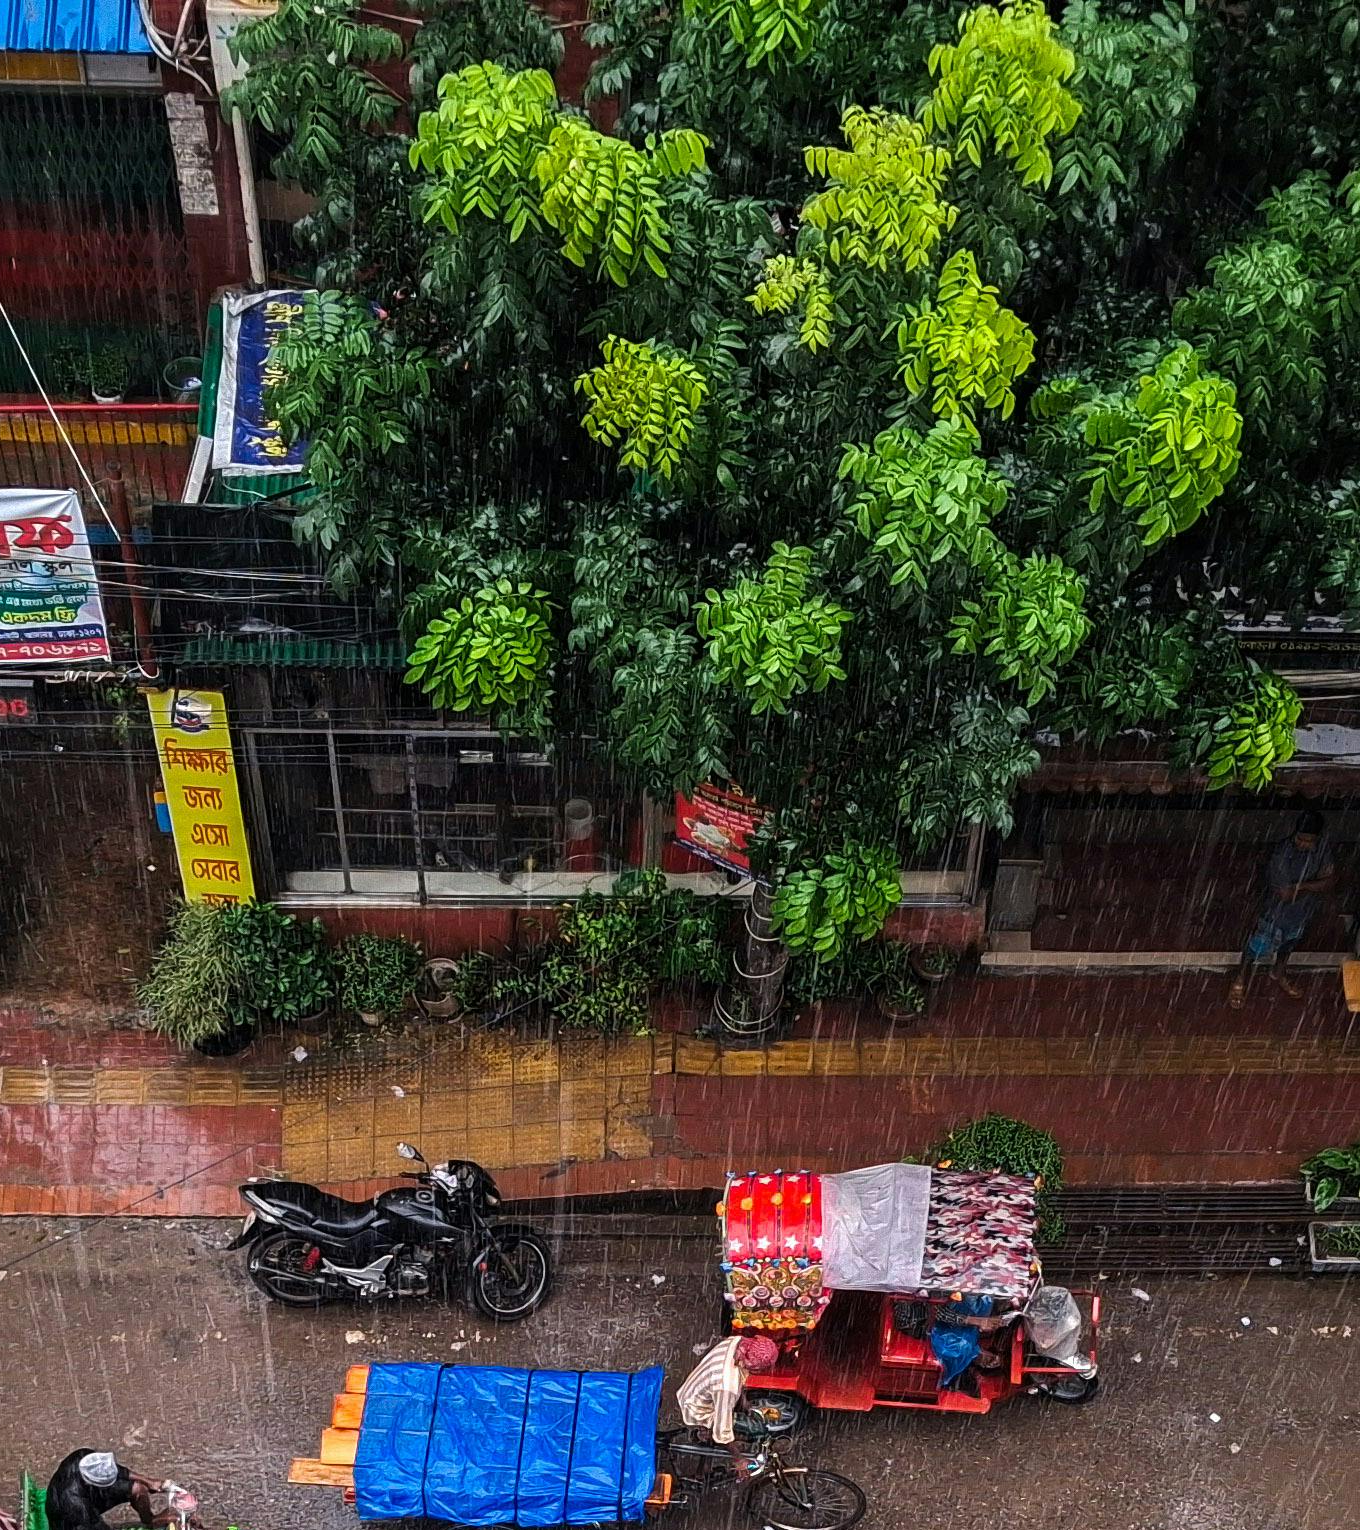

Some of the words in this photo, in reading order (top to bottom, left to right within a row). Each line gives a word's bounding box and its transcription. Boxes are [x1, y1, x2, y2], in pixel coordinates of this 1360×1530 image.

[0, 612, 52, 624] একদম
[54, 606, 78, 623] ফ্রি
[163, 738, 228, 776] শিক্ষার
[183, 786, 224, 810] জন্য
[191, 824, 230, 847] এসো
[191, 858, 241, 885] সেবার
